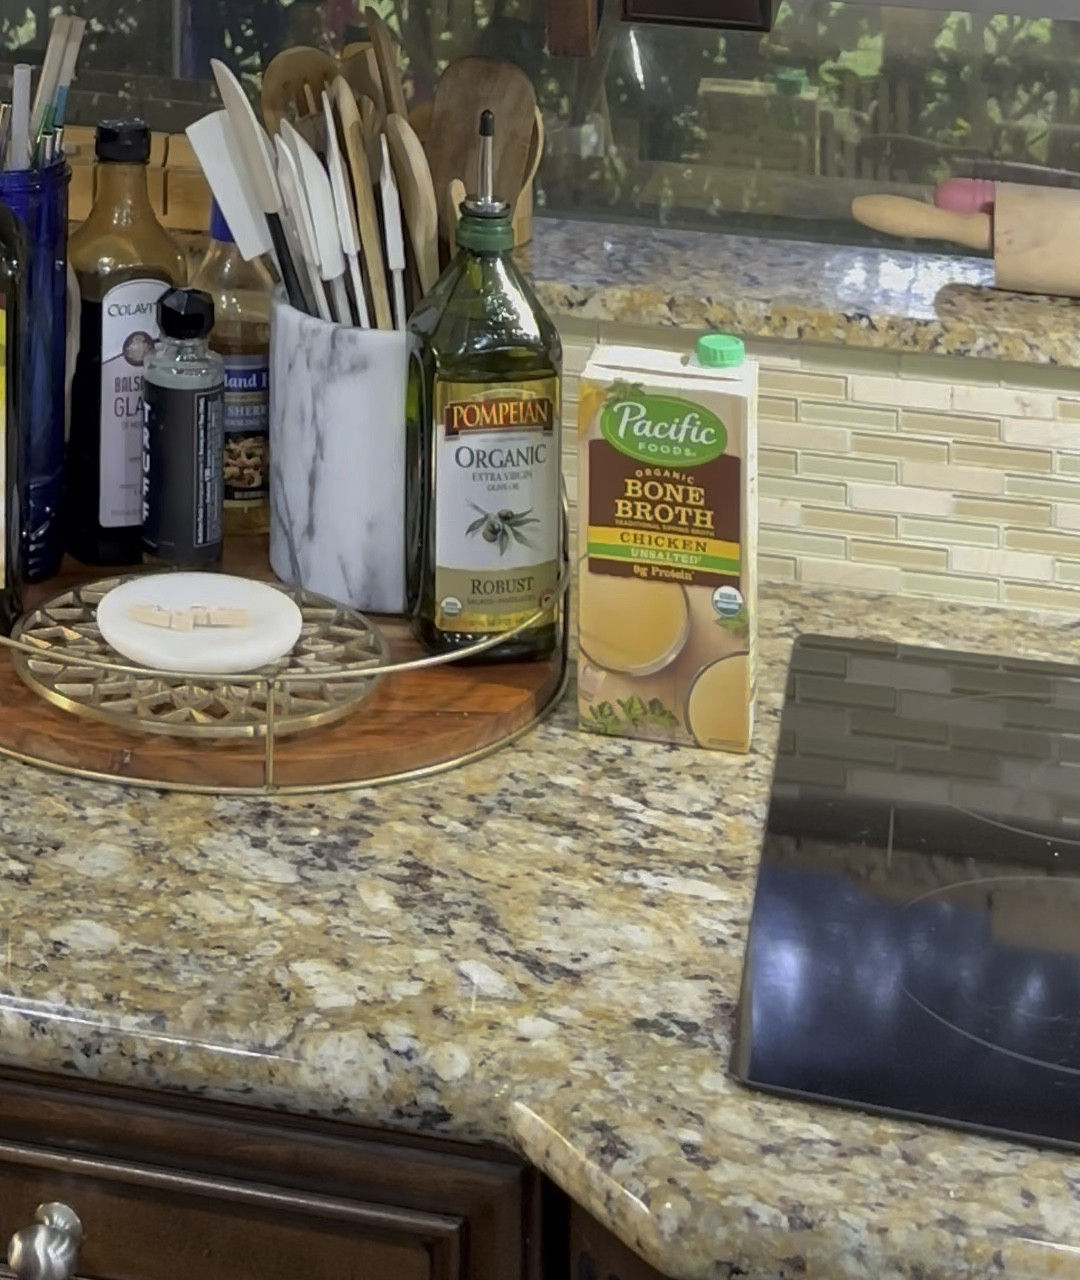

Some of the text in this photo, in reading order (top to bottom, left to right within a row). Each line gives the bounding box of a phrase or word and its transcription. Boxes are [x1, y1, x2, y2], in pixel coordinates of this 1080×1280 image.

[114, 375, 144, 393] BALS
[224, 373, 257, 388] land
[114, 395, 144, 417] GLA
[452, 400, 548, 428] POMPEIAN
[612, 401, 717, 445] Pacific
[454, 443, 547, 469] ORGANIC
[638, 442, 692, 457] FOODS
[635, 467, 695, 485] ORGANIC
[623, 478, 705, 506] BONE
[614, 499, 714, 530] BROTH
[620, 531, 708, 553] CHICKEN
[470, 576, 534, 595] ROBUST
